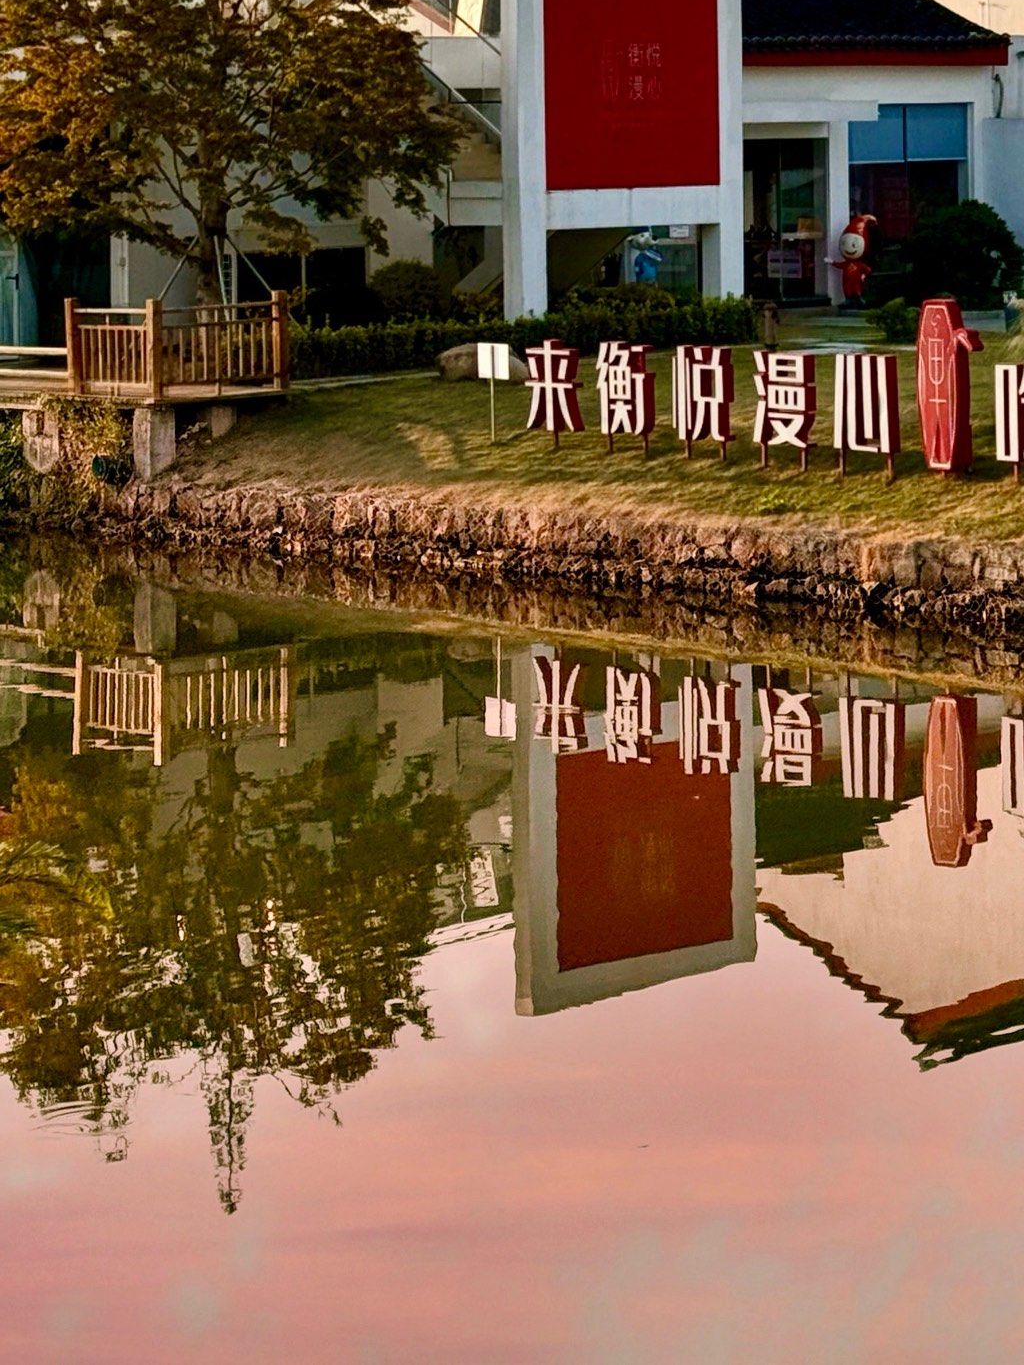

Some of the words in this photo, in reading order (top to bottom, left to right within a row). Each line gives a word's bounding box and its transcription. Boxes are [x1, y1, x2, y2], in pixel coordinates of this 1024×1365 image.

[525, 339, 898, 453] 来衡悦漫心
